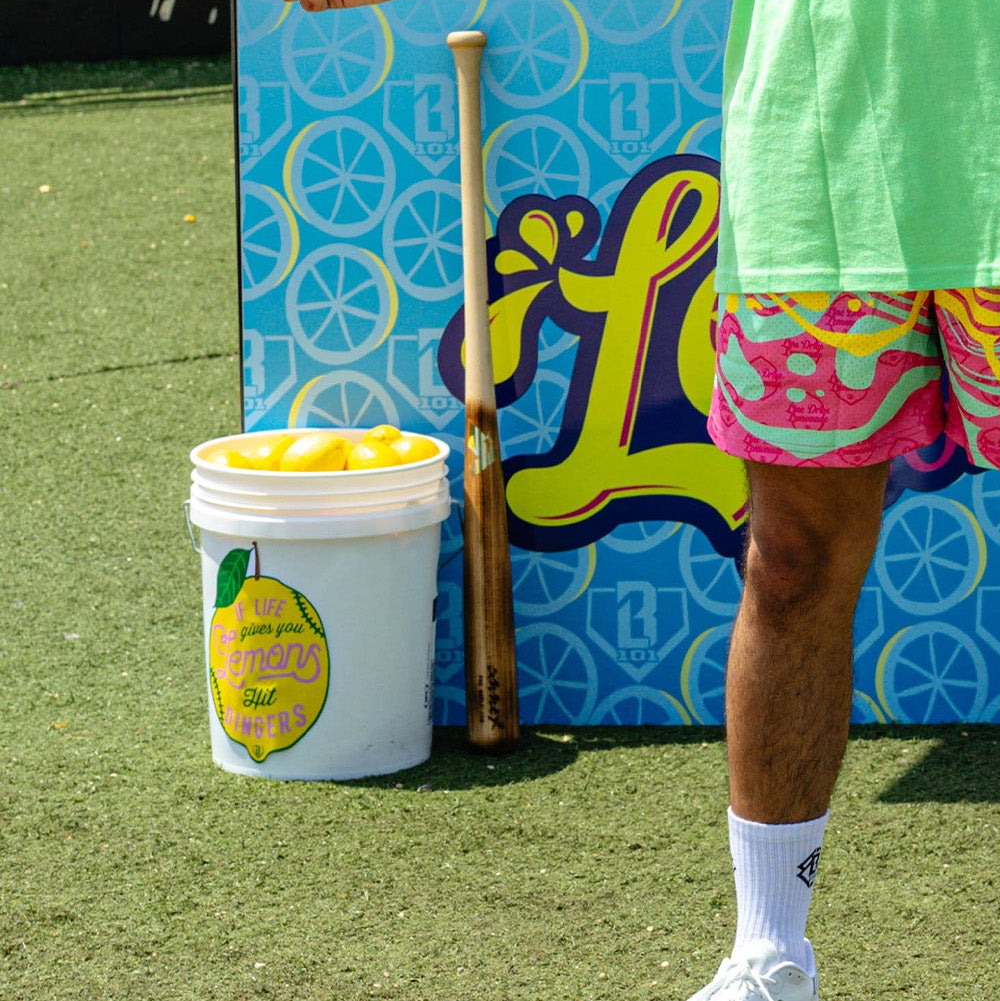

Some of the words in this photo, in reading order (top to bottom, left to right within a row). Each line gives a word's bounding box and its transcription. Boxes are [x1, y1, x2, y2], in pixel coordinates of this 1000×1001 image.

[240, 144, 262, 156] 01
[244, 397, 267, 410] 01
[234, 601, 245, 621] IF
[255, 598, 287, 618] LIFE
[240, 621, 273, 642] gives
[275, 622, 305, 638] you
[213, 623, 321, 689] Lemons
[243, 686, 277, 711] Hit
[225, 704, 307, 739] DINGERS
